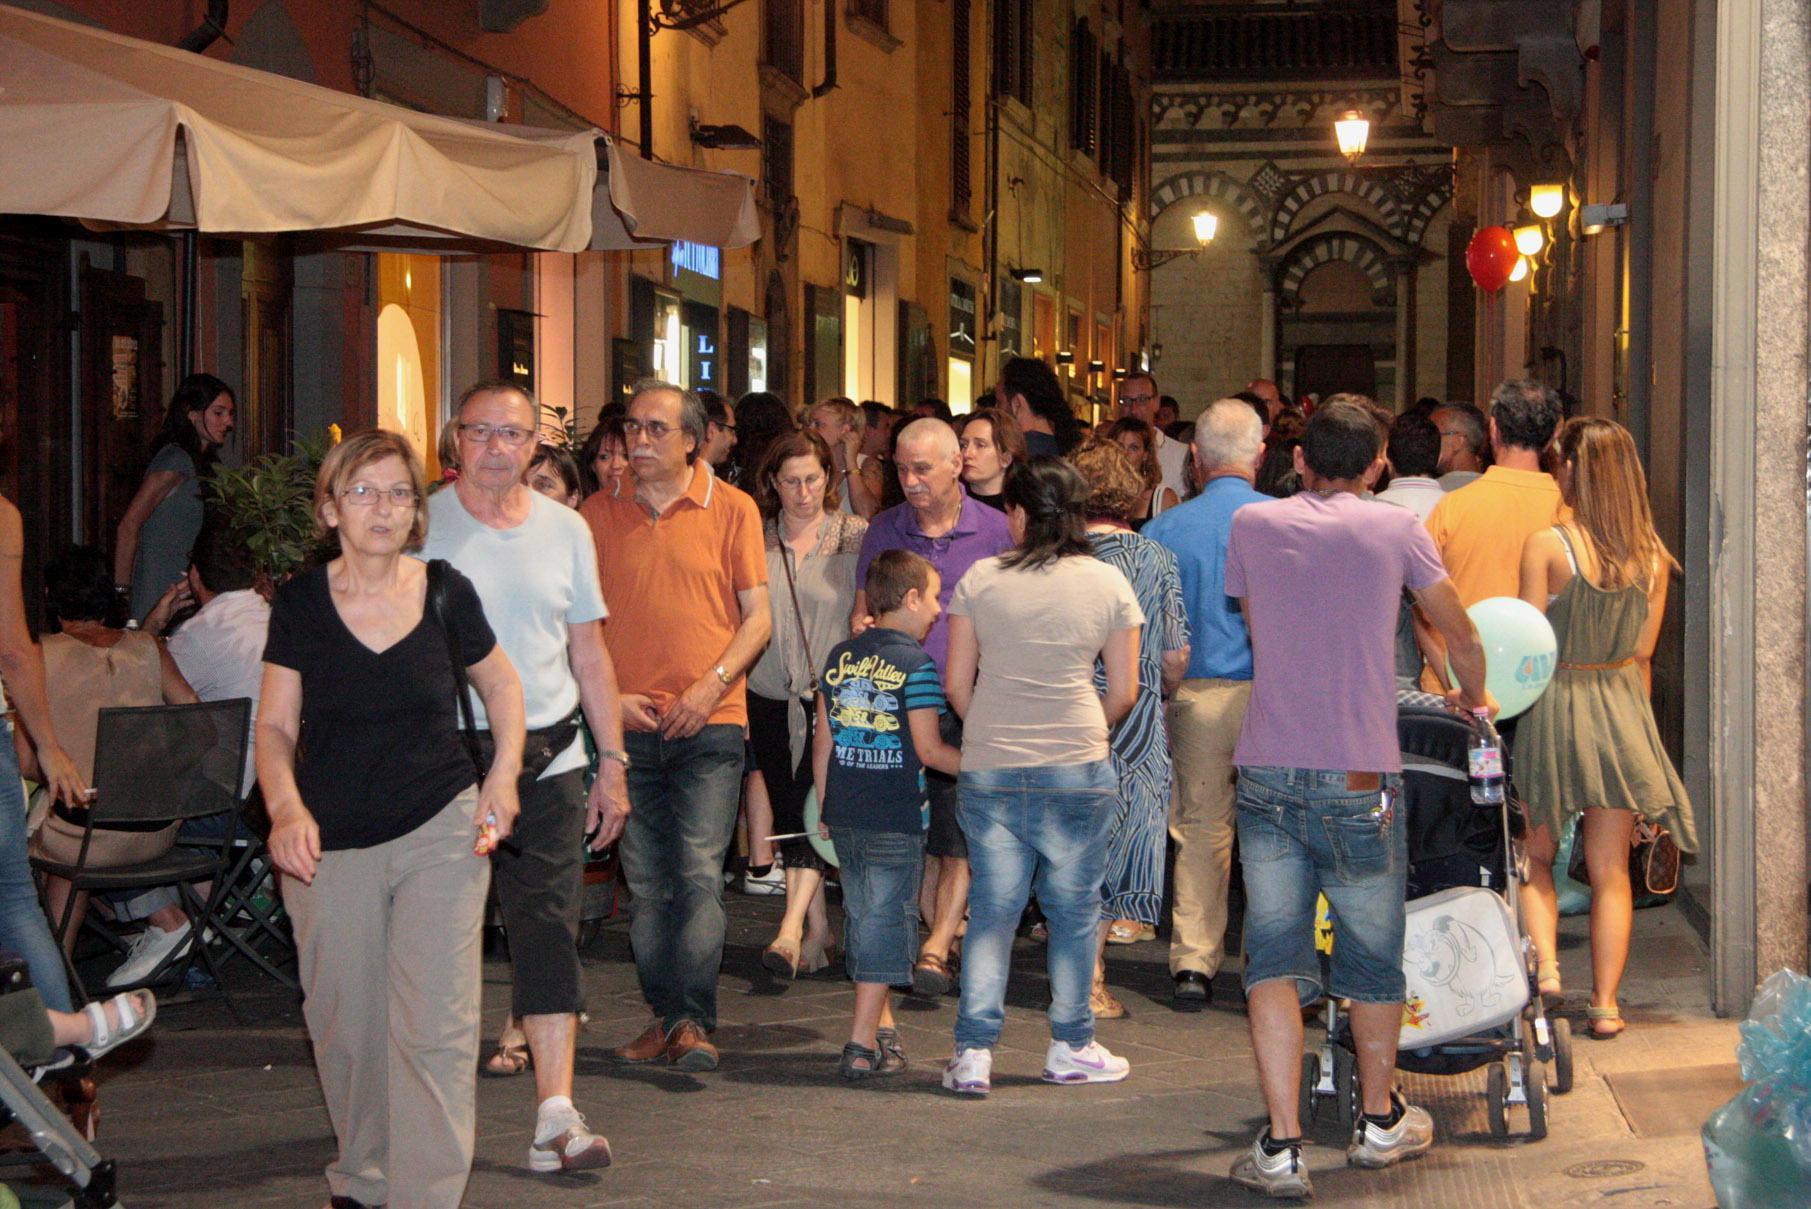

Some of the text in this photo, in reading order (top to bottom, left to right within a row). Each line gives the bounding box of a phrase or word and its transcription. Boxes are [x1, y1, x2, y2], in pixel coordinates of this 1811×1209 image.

[825, 651, 907, 688] Swift Valley
[857, 748, 904, 764] TRIALS
